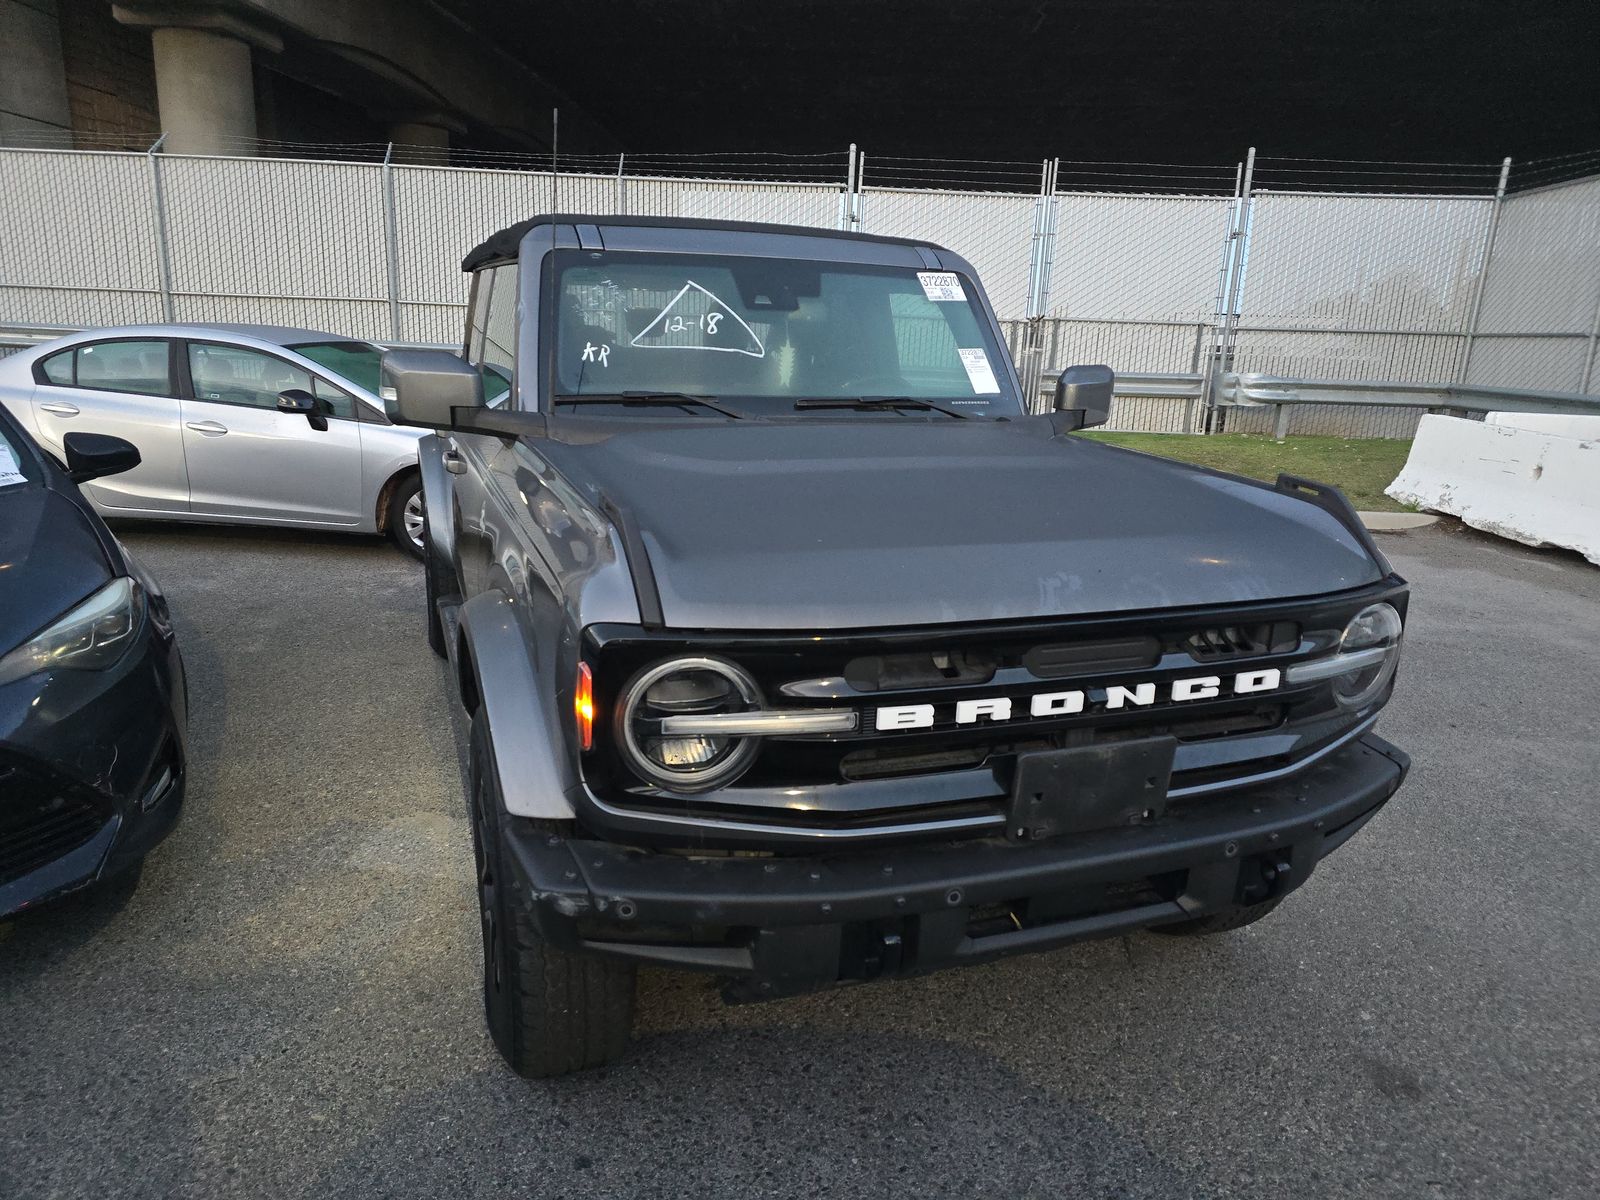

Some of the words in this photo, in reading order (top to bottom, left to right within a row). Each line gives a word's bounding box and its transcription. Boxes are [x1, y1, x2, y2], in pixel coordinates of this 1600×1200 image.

[920, 275, 960, 287] 3722870
[664, 312, 724, 335] 12-18
[876, 668, 1281, 731] BRONCO
